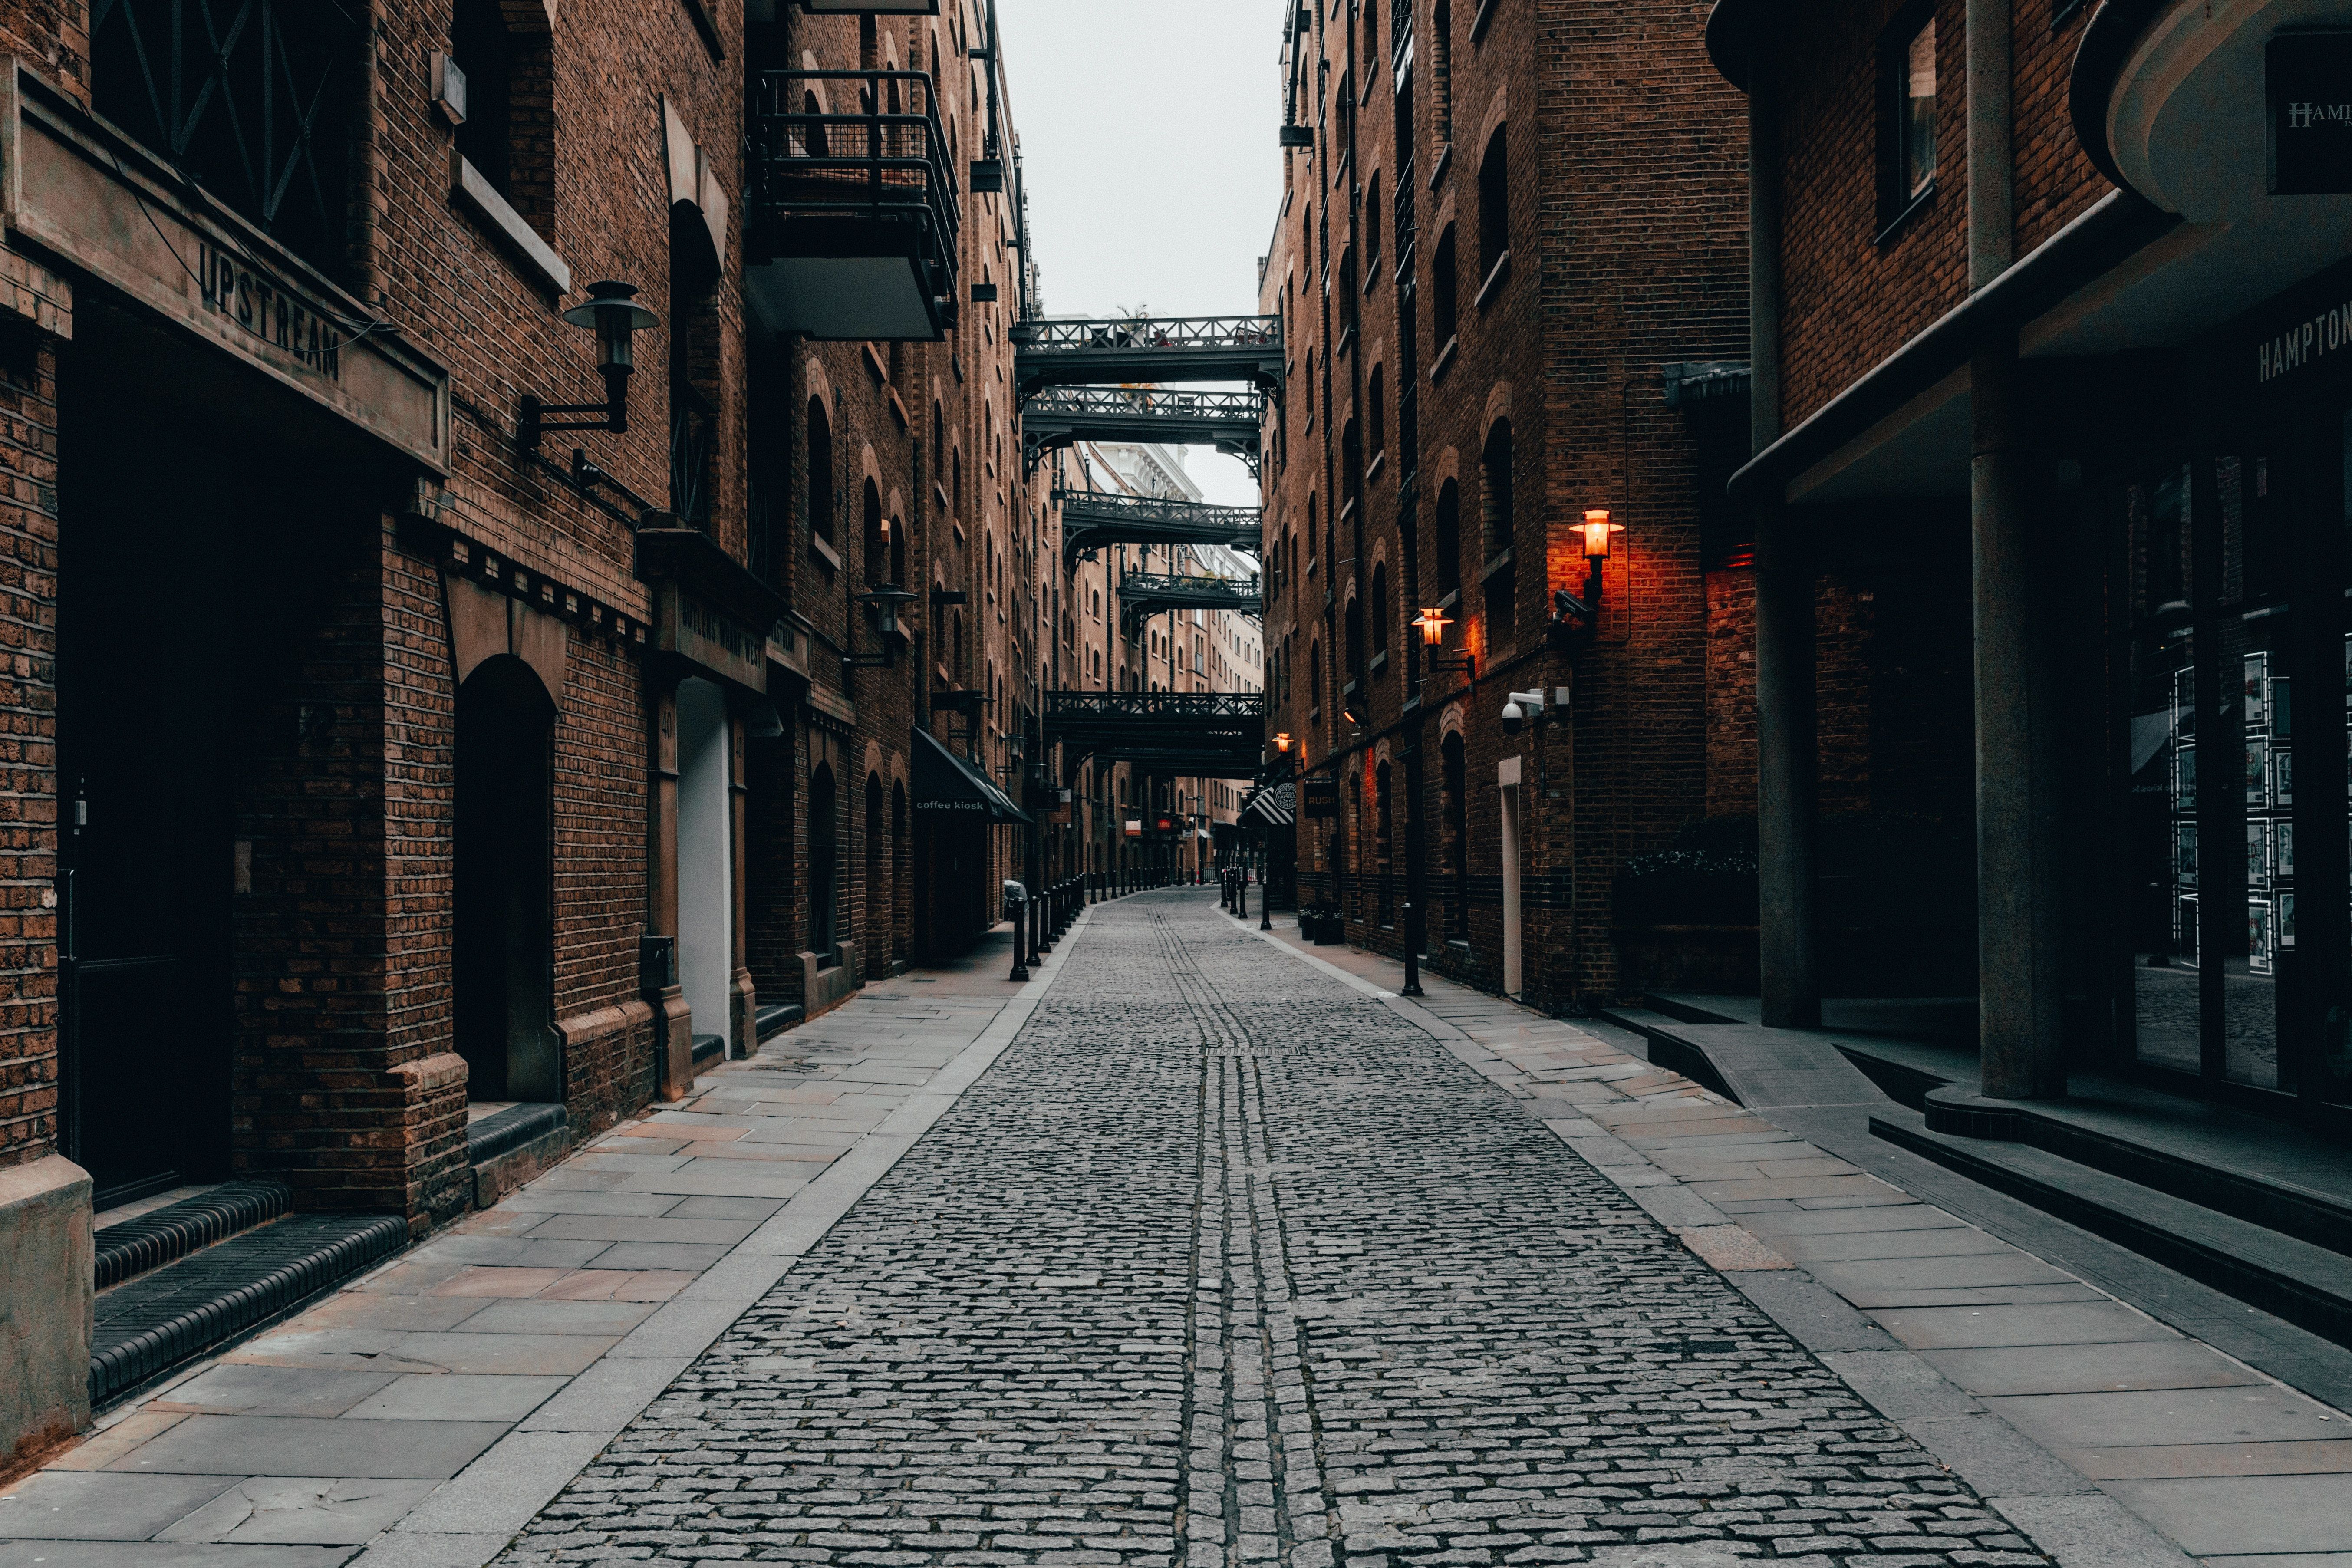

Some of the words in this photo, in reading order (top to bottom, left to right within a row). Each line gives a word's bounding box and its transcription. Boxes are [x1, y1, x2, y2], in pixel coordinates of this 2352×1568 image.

[200, 243, 338, 381] UPSTREAM
[2260, 300, 2352, 382] HAMPTON
[682, 598, 716, 644] BUTLERS
[745, 636, 761, 669] WEST
[662, 708, 672, 739] 40
[736, 736, 742, 758] 40
[955, 801, 983, 810] kiosk
